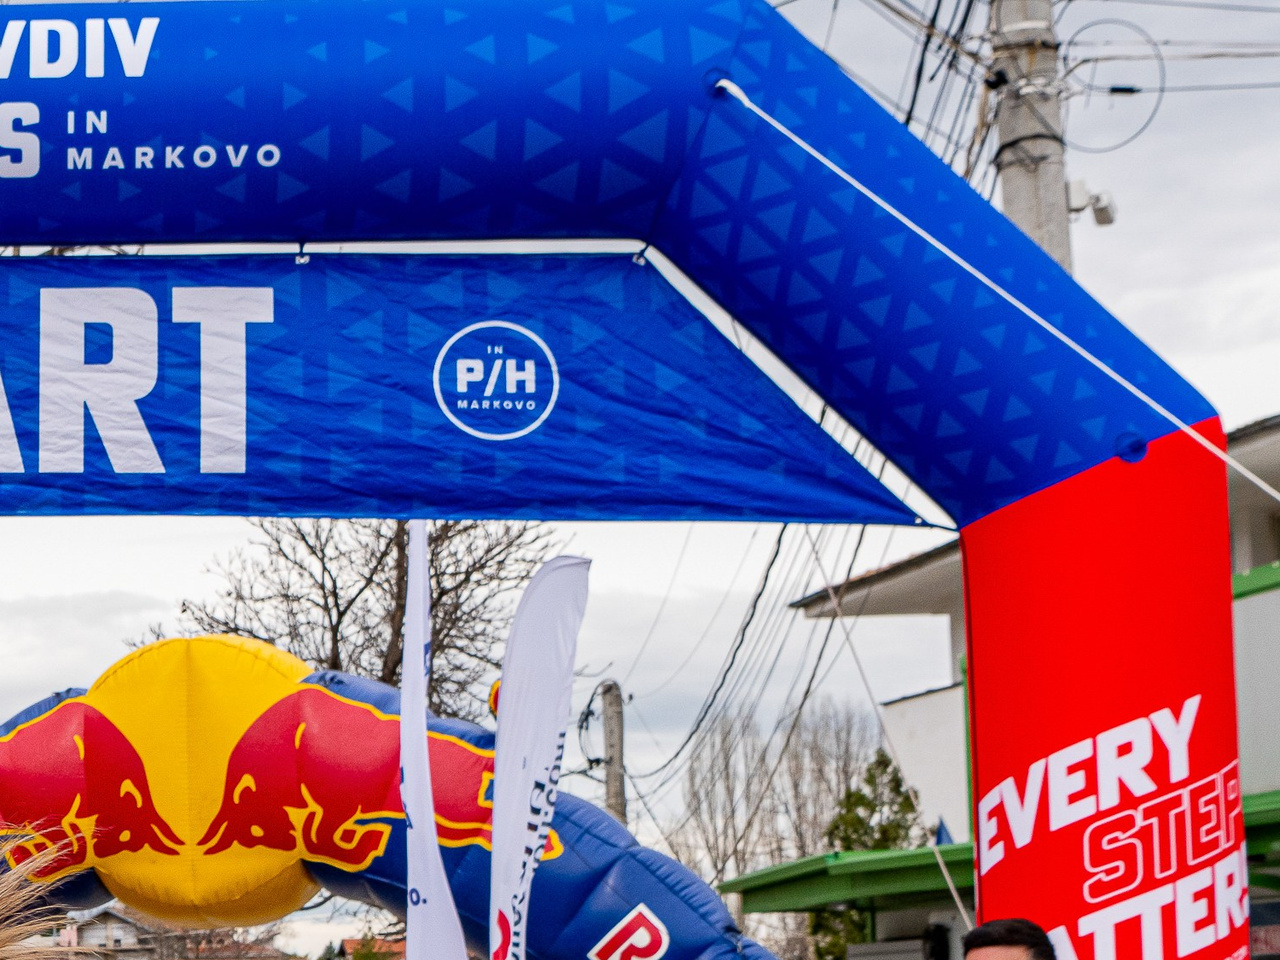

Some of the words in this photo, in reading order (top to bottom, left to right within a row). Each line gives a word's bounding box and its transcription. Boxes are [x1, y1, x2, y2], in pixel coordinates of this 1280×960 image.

[67, 111, 108, 134] IN
[67, 144, 281, 170] MARKOVO
[487, 345, 503, 355] IN
[456, 359, 536, 397] P/H
[457, 400, 536, 410] MARKOVO
[979, 694, 1202, 876] EVERY
[1083, 758, 1242, 904] STEP
